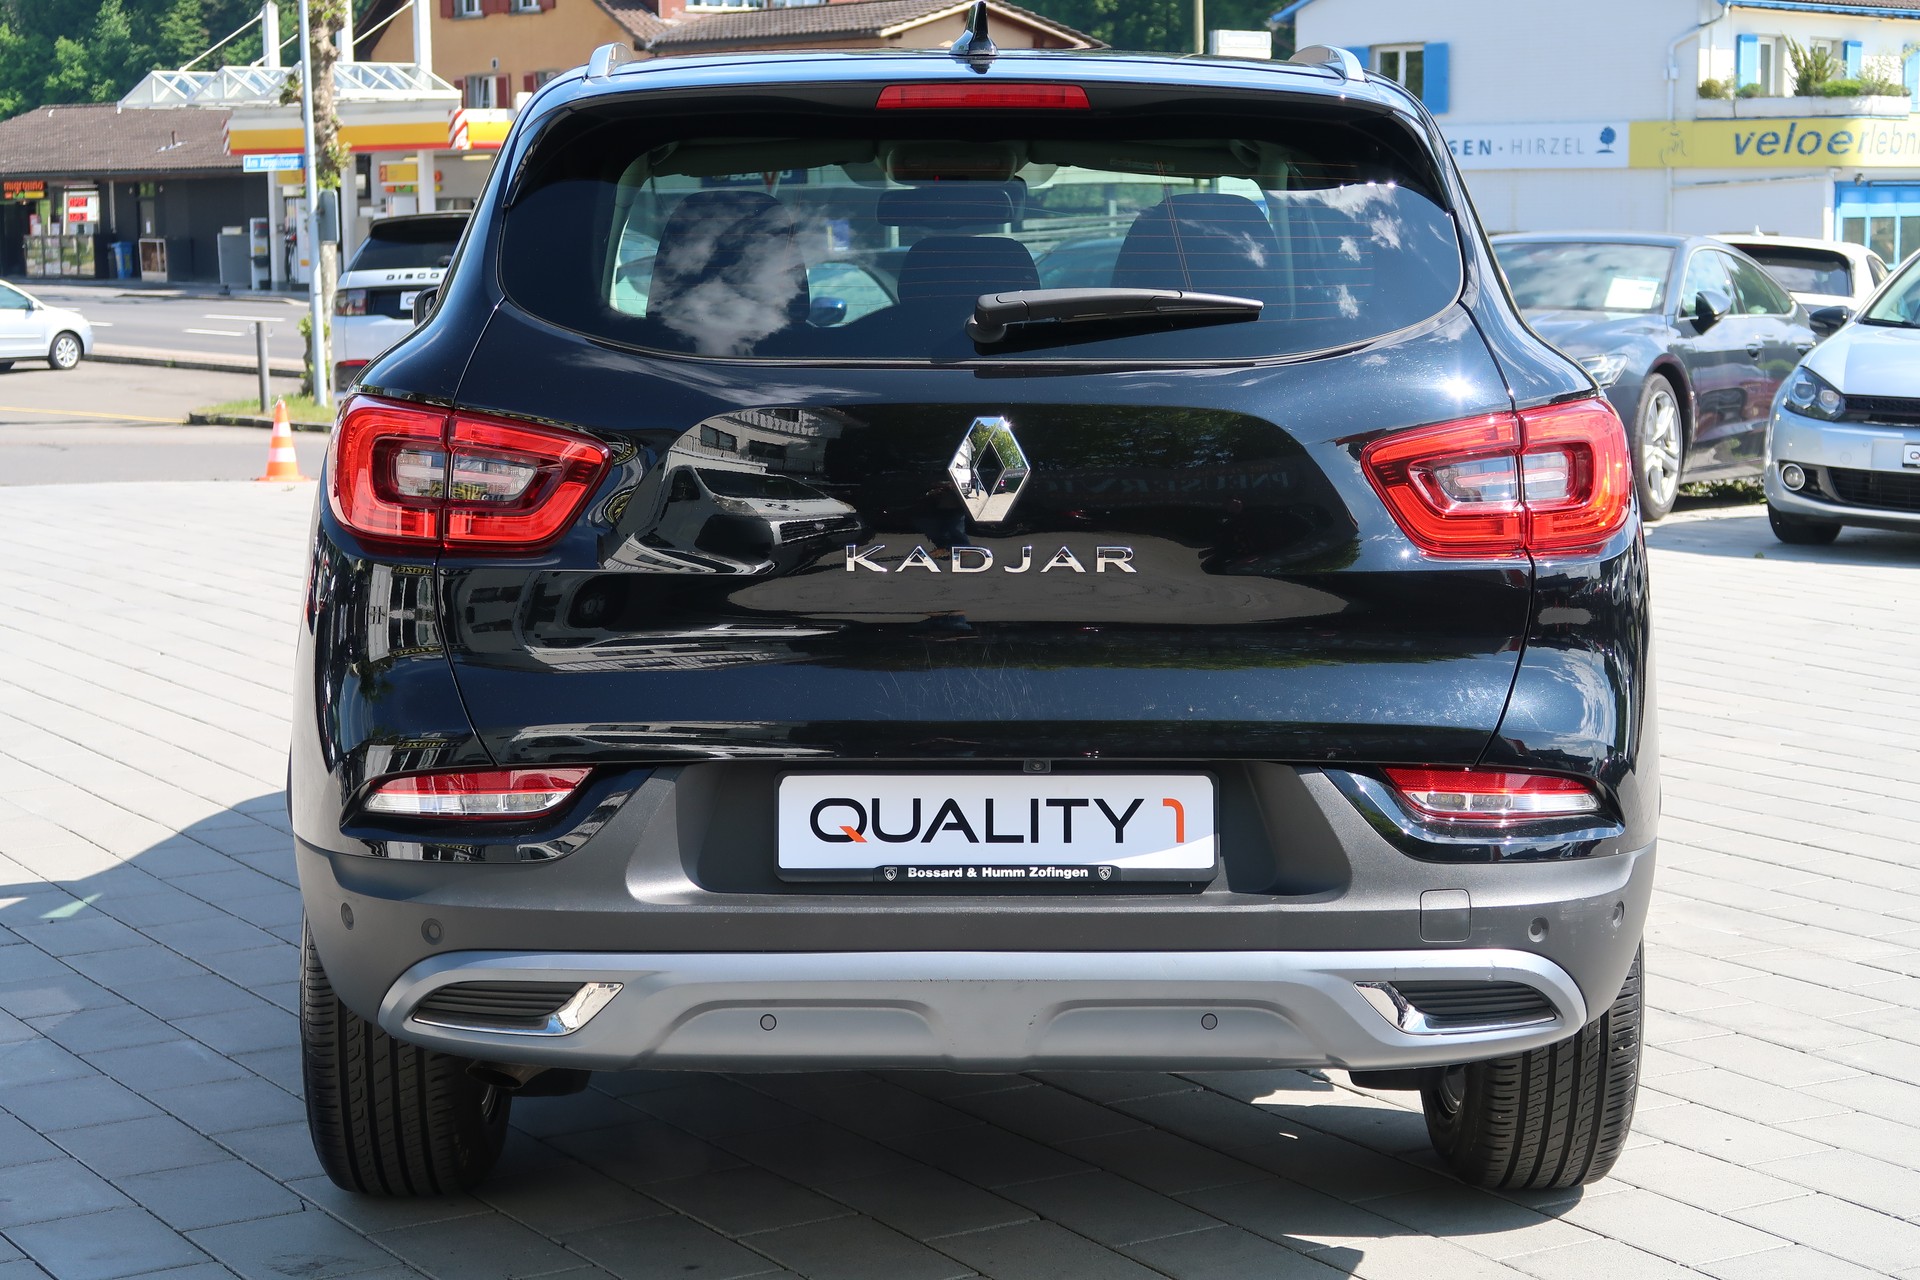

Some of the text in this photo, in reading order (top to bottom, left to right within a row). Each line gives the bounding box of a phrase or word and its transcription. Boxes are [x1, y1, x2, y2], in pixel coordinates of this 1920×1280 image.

[1511, 137, 1585, 155] HIRZEL
[845, 545, 1137, 573] KADJAR
[809, 797, 1185, 843] QUALITY 1
[907, 866, 1088, 879] Bossard & Humm Zofingen
